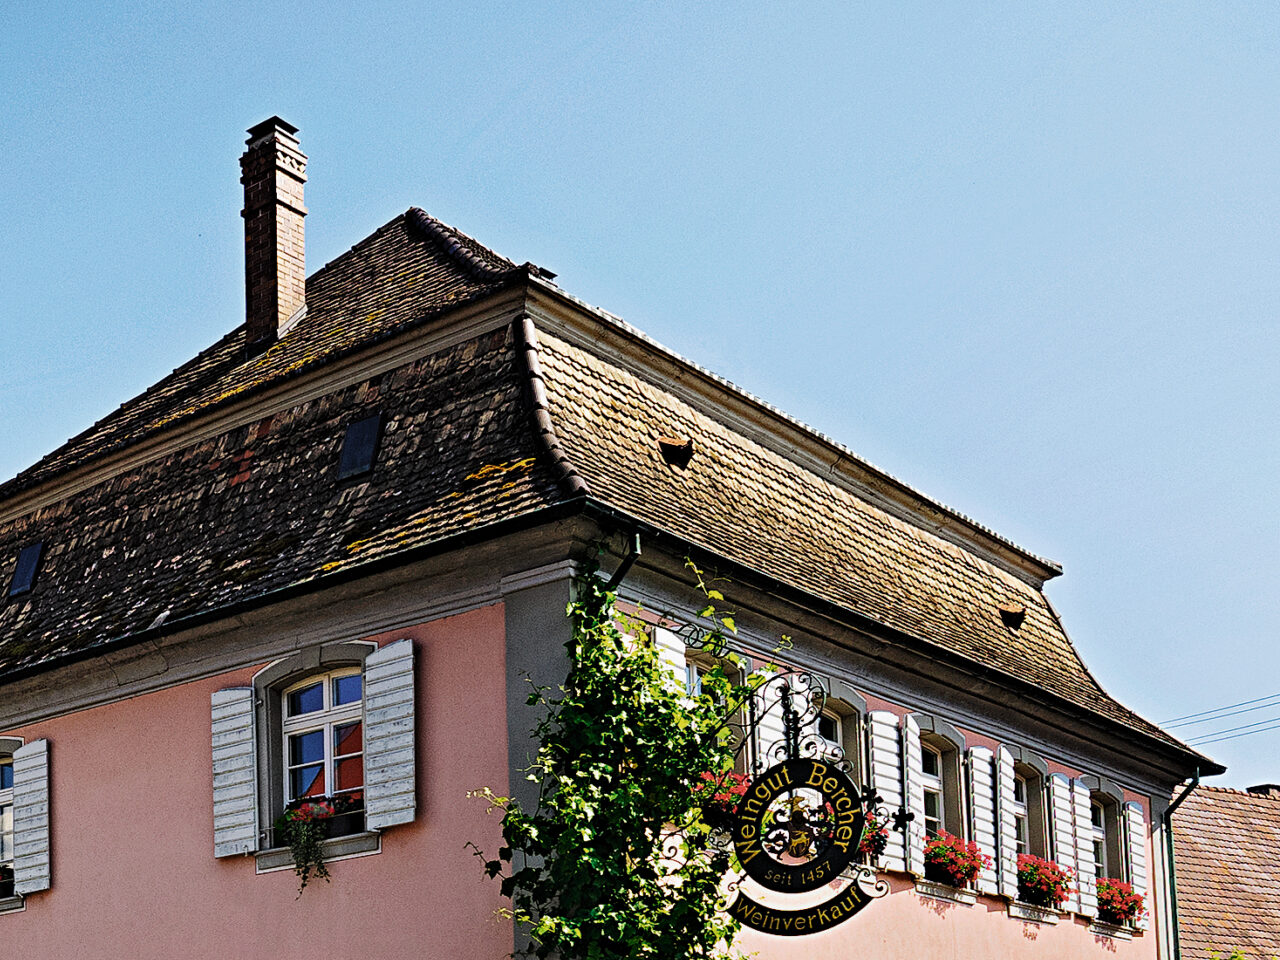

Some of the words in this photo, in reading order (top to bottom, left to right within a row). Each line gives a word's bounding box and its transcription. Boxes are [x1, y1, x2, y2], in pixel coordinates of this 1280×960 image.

[736, 765, 793, 864] Weingut
[805, 761, 861, 853] Bercher
[801, 860, 832, 885] 1457
[736, 885, 862, 931] Weinverkauf
